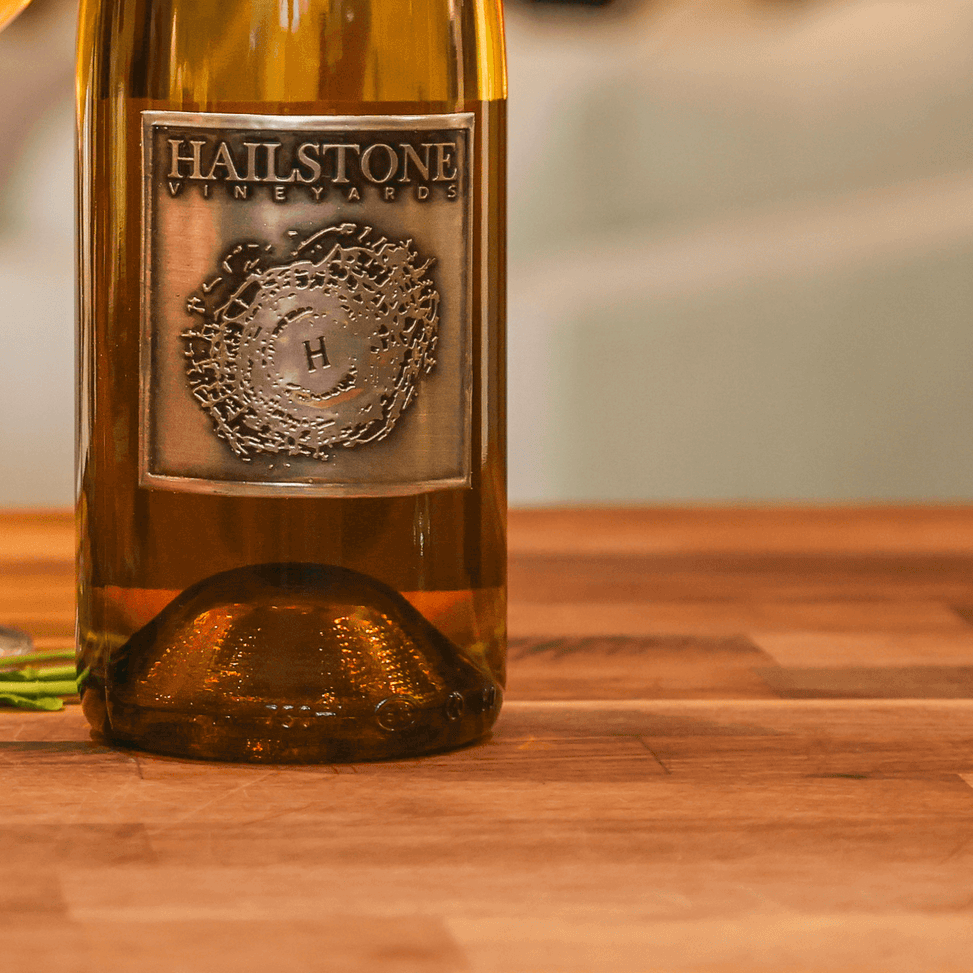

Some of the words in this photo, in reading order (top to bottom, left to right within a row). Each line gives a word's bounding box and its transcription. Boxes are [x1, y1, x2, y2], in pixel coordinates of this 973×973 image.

[167, 139, 458, 185] HAILSTONE
[167, 182, 458, 201] VINEYARDS
[302, 335, 331, 373] H
